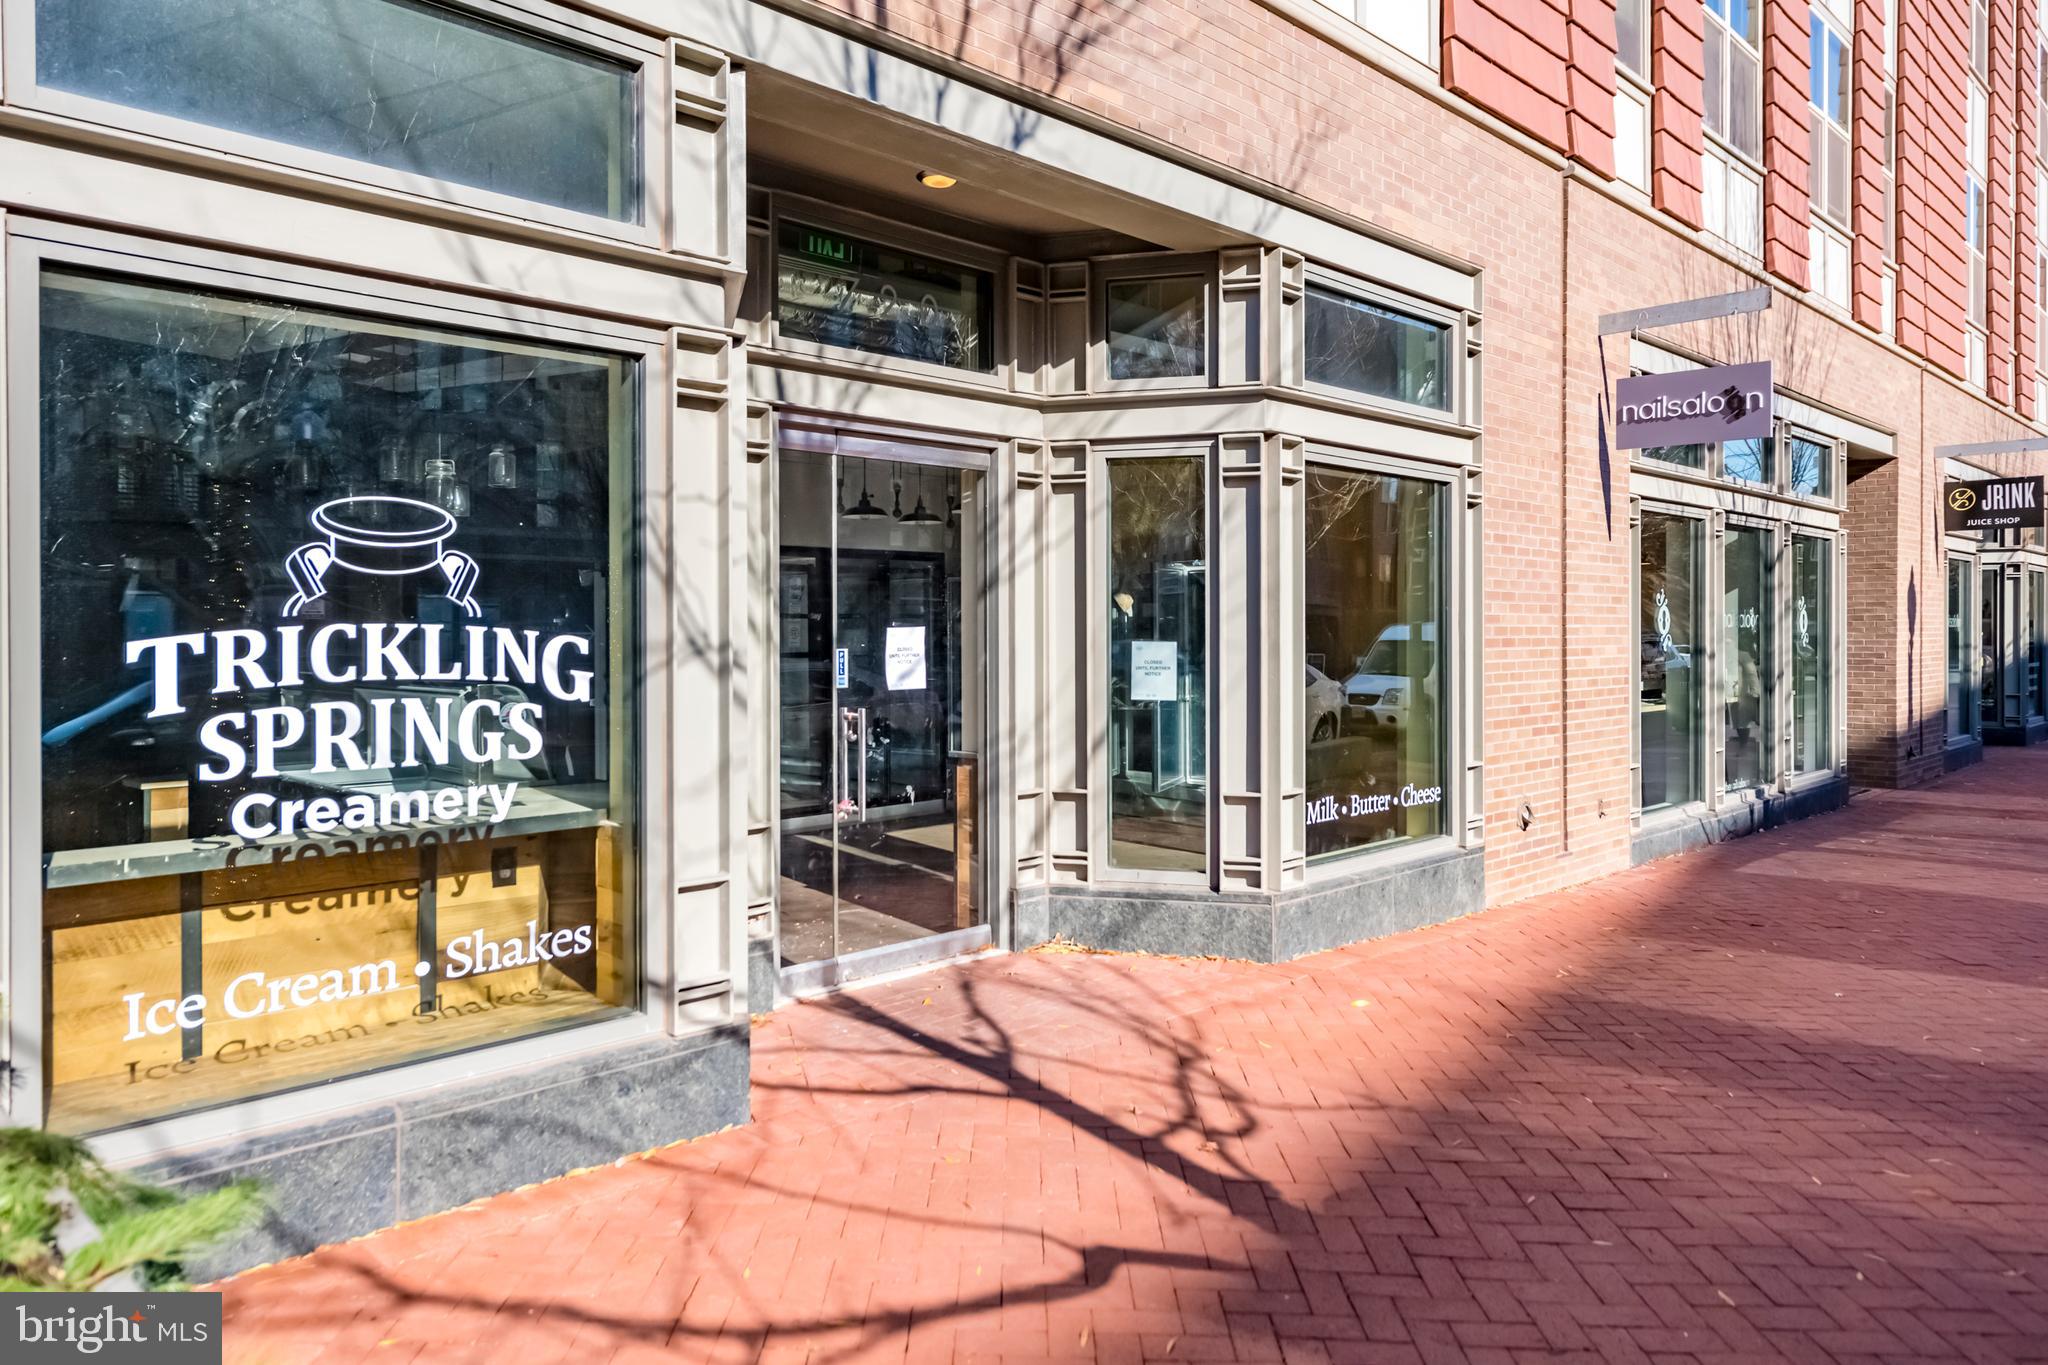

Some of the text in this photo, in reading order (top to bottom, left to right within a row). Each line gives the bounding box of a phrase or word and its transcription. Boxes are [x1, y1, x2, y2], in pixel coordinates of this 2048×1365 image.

[1967, 518, 1992, 526] JUICE
[1982, 482, 2035, 510] JRINK
[125, 623, 595, 719] TRICKLING
[198, 698, 544, 781] SPRINGS
[230, 782, 518, 839] Creamery
[1306, 783, 1442, 825] Milk Butter Cheese
[123, 920, 592, 1041] Ice Cream Shakes
